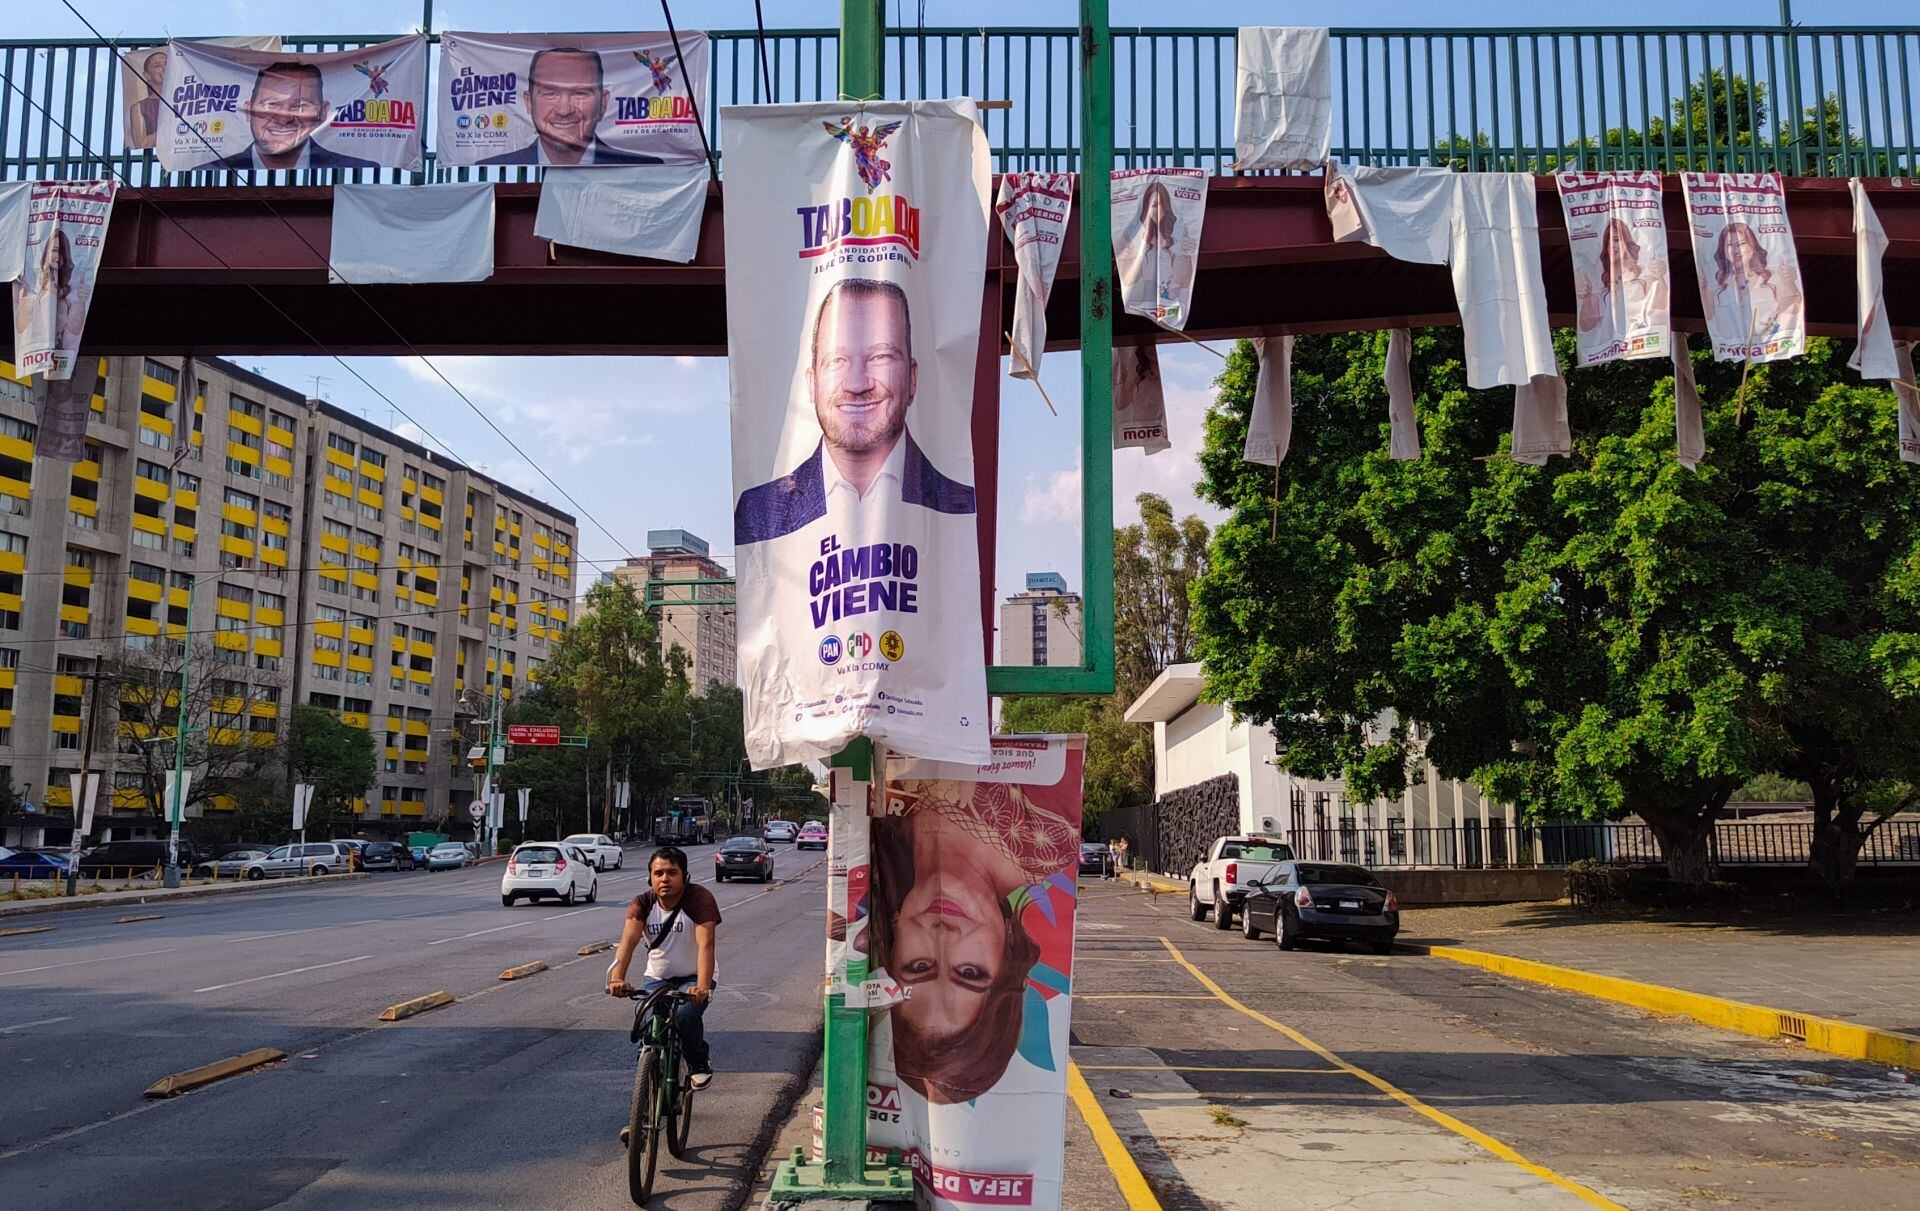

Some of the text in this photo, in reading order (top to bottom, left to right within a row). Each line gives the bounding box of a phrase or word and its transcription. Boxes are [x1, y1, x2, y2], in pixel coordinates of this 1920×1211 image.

[183, 75, 197, 85] EL
[460, 66, 474, 77] EL
[173, 84, 240, 103] CAMBIO
[451, 72, 516, 96] CAMBIO
[173, 99, 237, 118] VIENE
[333, 99, 416, 124] TABOADA
[451, 91, 516, 111] VIENE
[615, 97, 697, 120] TABOADA
[1176, 190, 1200, 200] VOTA
[1573, 207, 1597, 215] JEFA
[797, 195, 919, 252] TABOADA
[834, 245, 887, 257] CANDIDATO
[814, 252, 912, 274] JEFE DE GOBIERNO
[820, 534, 841, 557] EL
[809, 543, 918, 597] CAMBIO
[810, 581, 918, 630] VIENE
[822, 641, 839, 659] PAN
[848, 635, 870, 653] PRI
[837, 662, 890, 675] Va X la CDMX
[1016, 750, 1035, 758] QUE
[867, 1086, 901, 1109] VO
[869, 1109, 900, 1124] 2 DE
[933, 1171, 1024, 1197] JEFA DE
